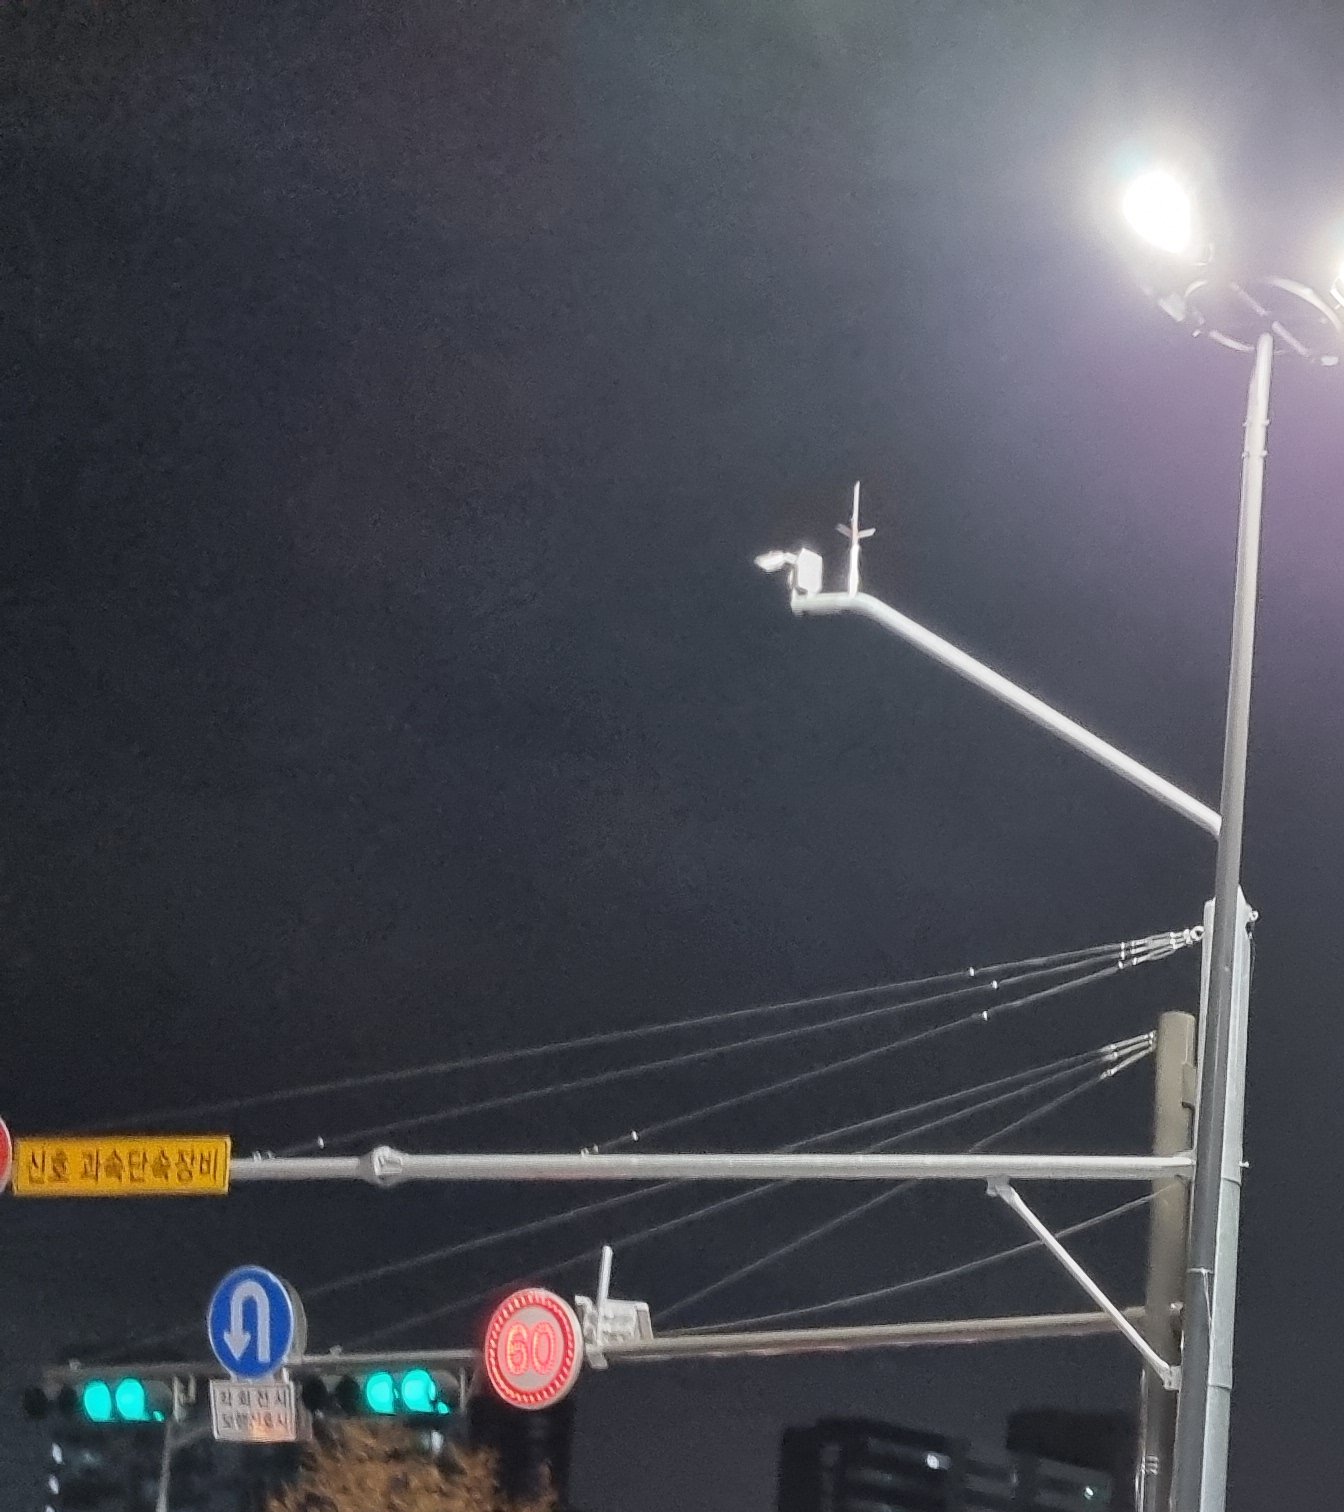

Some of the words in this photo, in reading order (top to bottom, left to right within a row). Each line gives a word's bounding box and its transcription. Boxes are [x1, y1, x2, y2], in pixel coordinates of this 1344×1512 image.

[28, 1149, 70, 1185] 신호
[80, 1147, 219, 1185] 과속단속장비
[506, 1321, 555, 1376] 60
